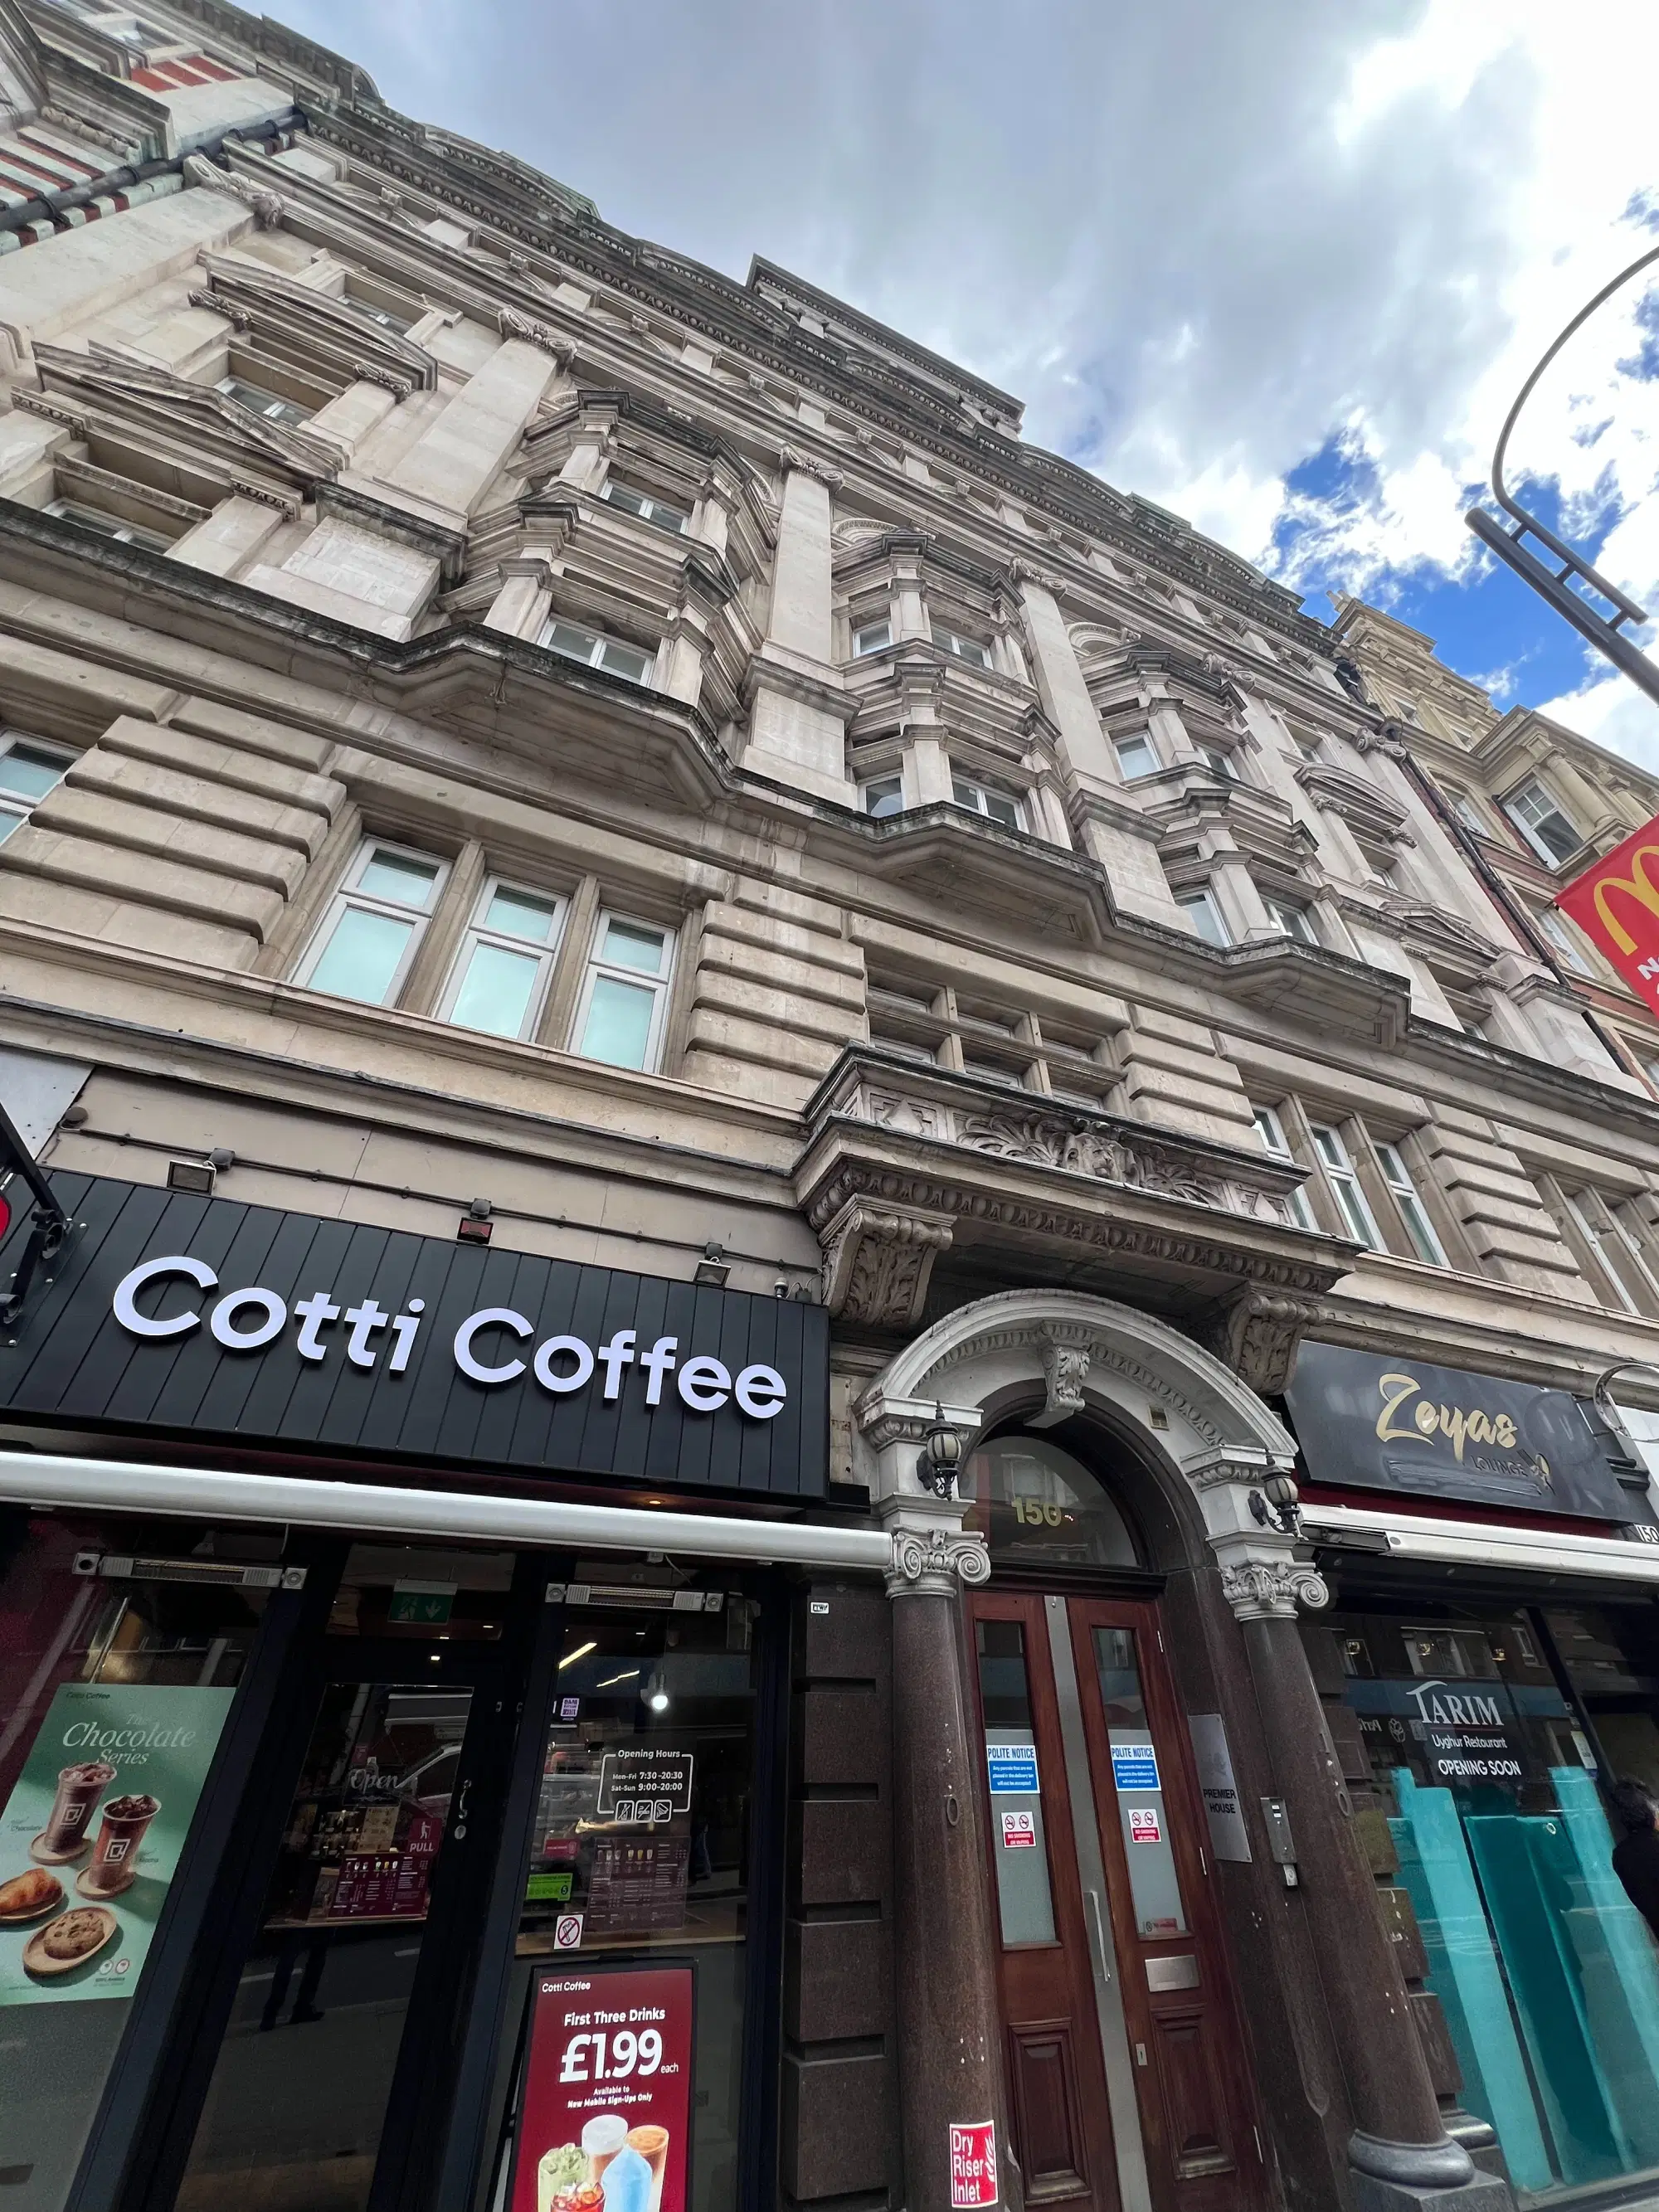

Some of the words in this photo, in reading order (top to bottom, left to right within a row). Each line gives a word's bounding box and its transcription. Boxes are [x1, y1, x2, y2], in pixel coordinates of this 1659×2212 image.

[113, 1255, 426, 1373] Cotti
[453, 1307, 787, 1420] Coffee
[1011, 1497, 1062, 1526] 150
[1406, 1680, 1505, 1726] TARIM
[62, 1722, 197, 1748] Chocolate
[1432, 1734, 1462, 1749] Uyghur
[1464, 1734, 1508, 1748] Restaurant
[96, 1748, 150, 1765] Series
[618, 1749, 654, 1759] Opening
[987, 1748, 1010, 1758] POLITE
[1012, 1748, 1034, 1758] NOTICE
[1112, 1748, 1131, 1757] POLITE
[1132, 1748, 1154, 1757] NOTICE
[1438, 1759, 1488, 1776] OPENING
[1488, 1760, 1522, 1776] SOON
[349, 1768, 399, 1794] Open
[1203, 1788, 1236, 1799] PREMIER
[1209, 1803, 1236, 1814] HOUSE
[409, 1842, 435, 1853] PULL
[542, 1982, 562, 1992] Cotti
[564, 1981, 591, 1991] Coffee
[564, 2012, 591, 2026] First
[594, 2010, 626, 2025] Three
[629, 2007, 665, 2022] Drinks
[559, 2029, 663, 2083] £1.99
[660, 2063, 679, 2073] each
[593, 2087, 621, 2095] Available
[567, 2100, 582, 2108] New
[584, 2098, 606, 2107] Mobile
[607, 2094, 636, 2106] Sign-Ups
[637, 2093, 653, 2102] Only
[952, 2130, 974, 2156] Dry
[953, 2154, 985, 2177] Riser
[954, 2179, 981, 2203] Inlet
